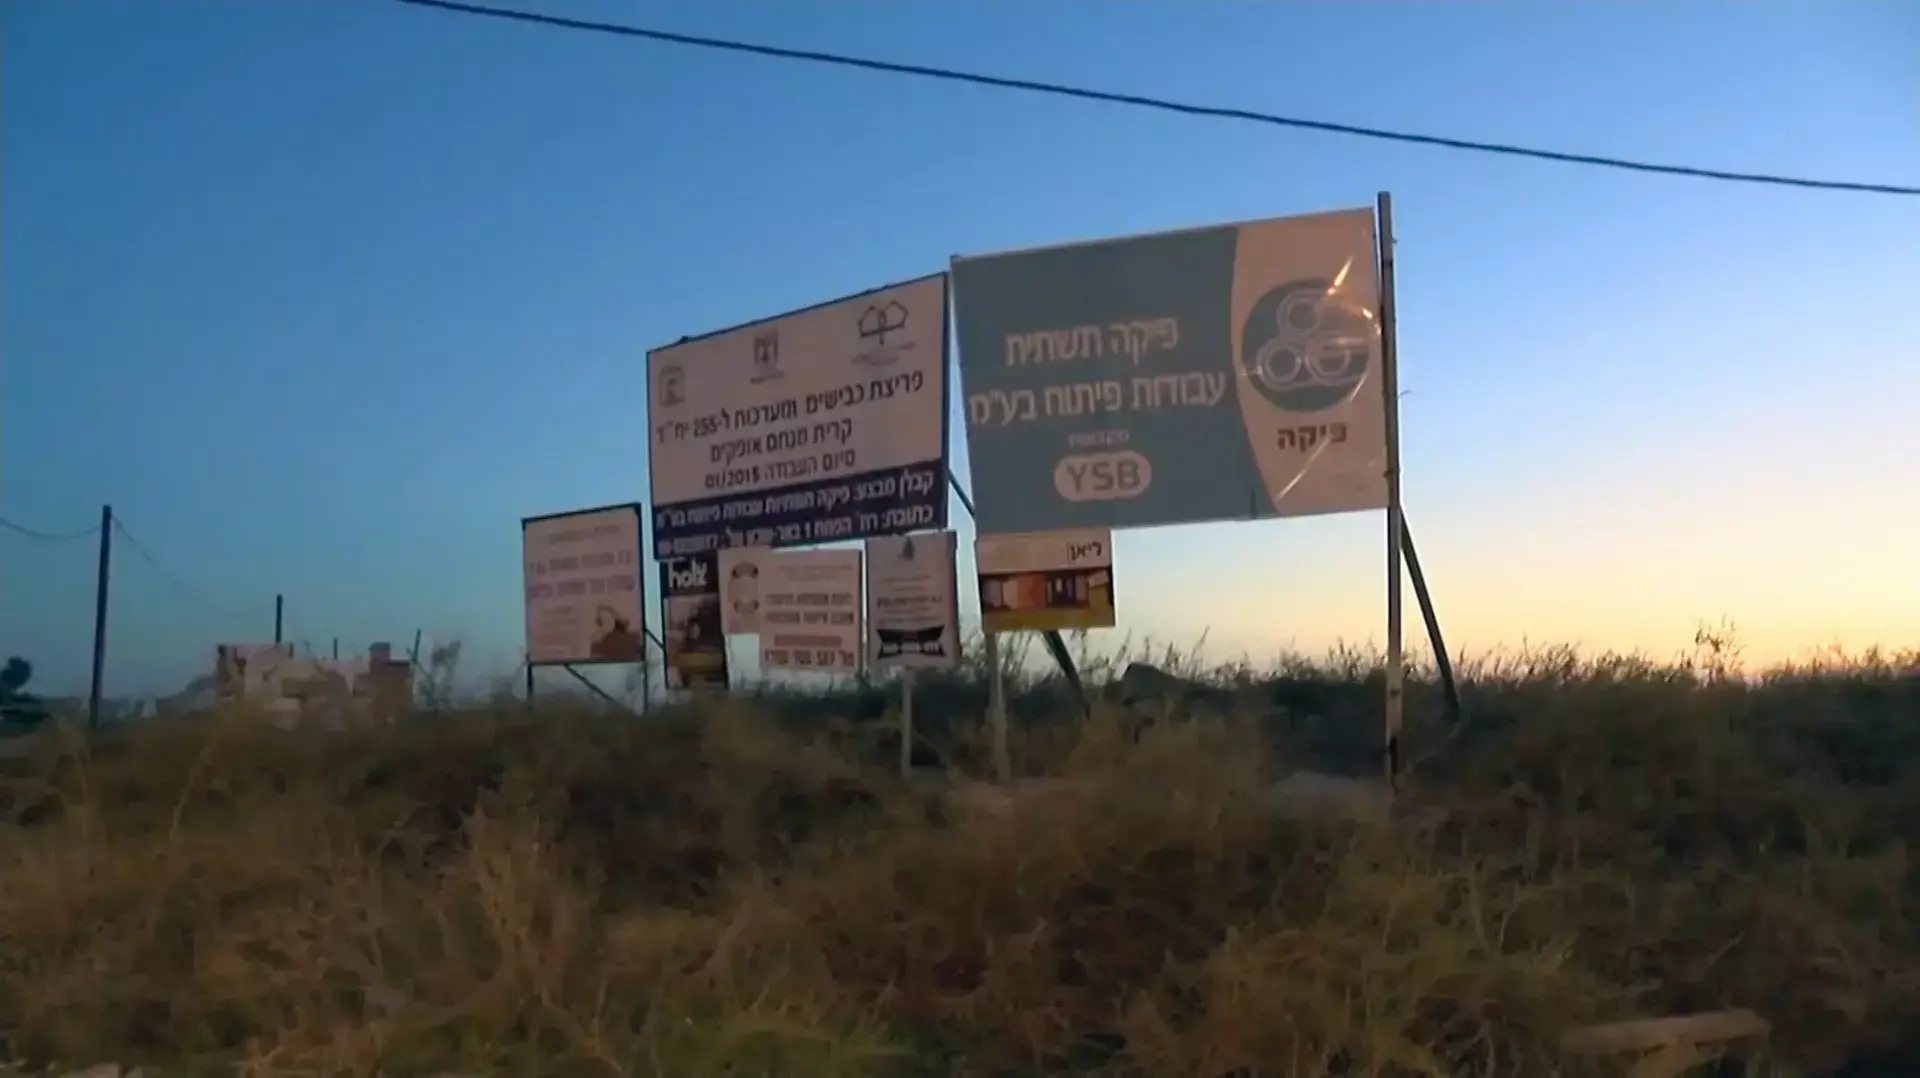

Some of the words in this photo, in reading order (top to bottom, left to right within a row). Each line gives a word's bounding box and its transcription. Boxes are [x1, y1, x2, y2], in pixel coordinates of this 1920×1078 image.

[1110, 316, 1179, 366] פיקה
[805, 383, 865, 415] כבישים
[870, 369, 924, 401] פריצת
[1044, 380, 1122, 417] פיתוח
[1131, 371, 1227, 411] עבודות
[734, 398, 797, 430] ומערכות
[968, 388, 1036, 426] בע"מ
[766, 426, 808, 452] מנחם
[812, 418, 852, 445] קרית
[1277, 423, 1348, 453] פיקה
[711, 436, 762, 466] אופקים
[822, 448, 856, 471] סיום
[764, 456, 818, 481] העבודה
[898, 468, 934, 499] קבלן
[1067, 458, 1141, 494] YSB
